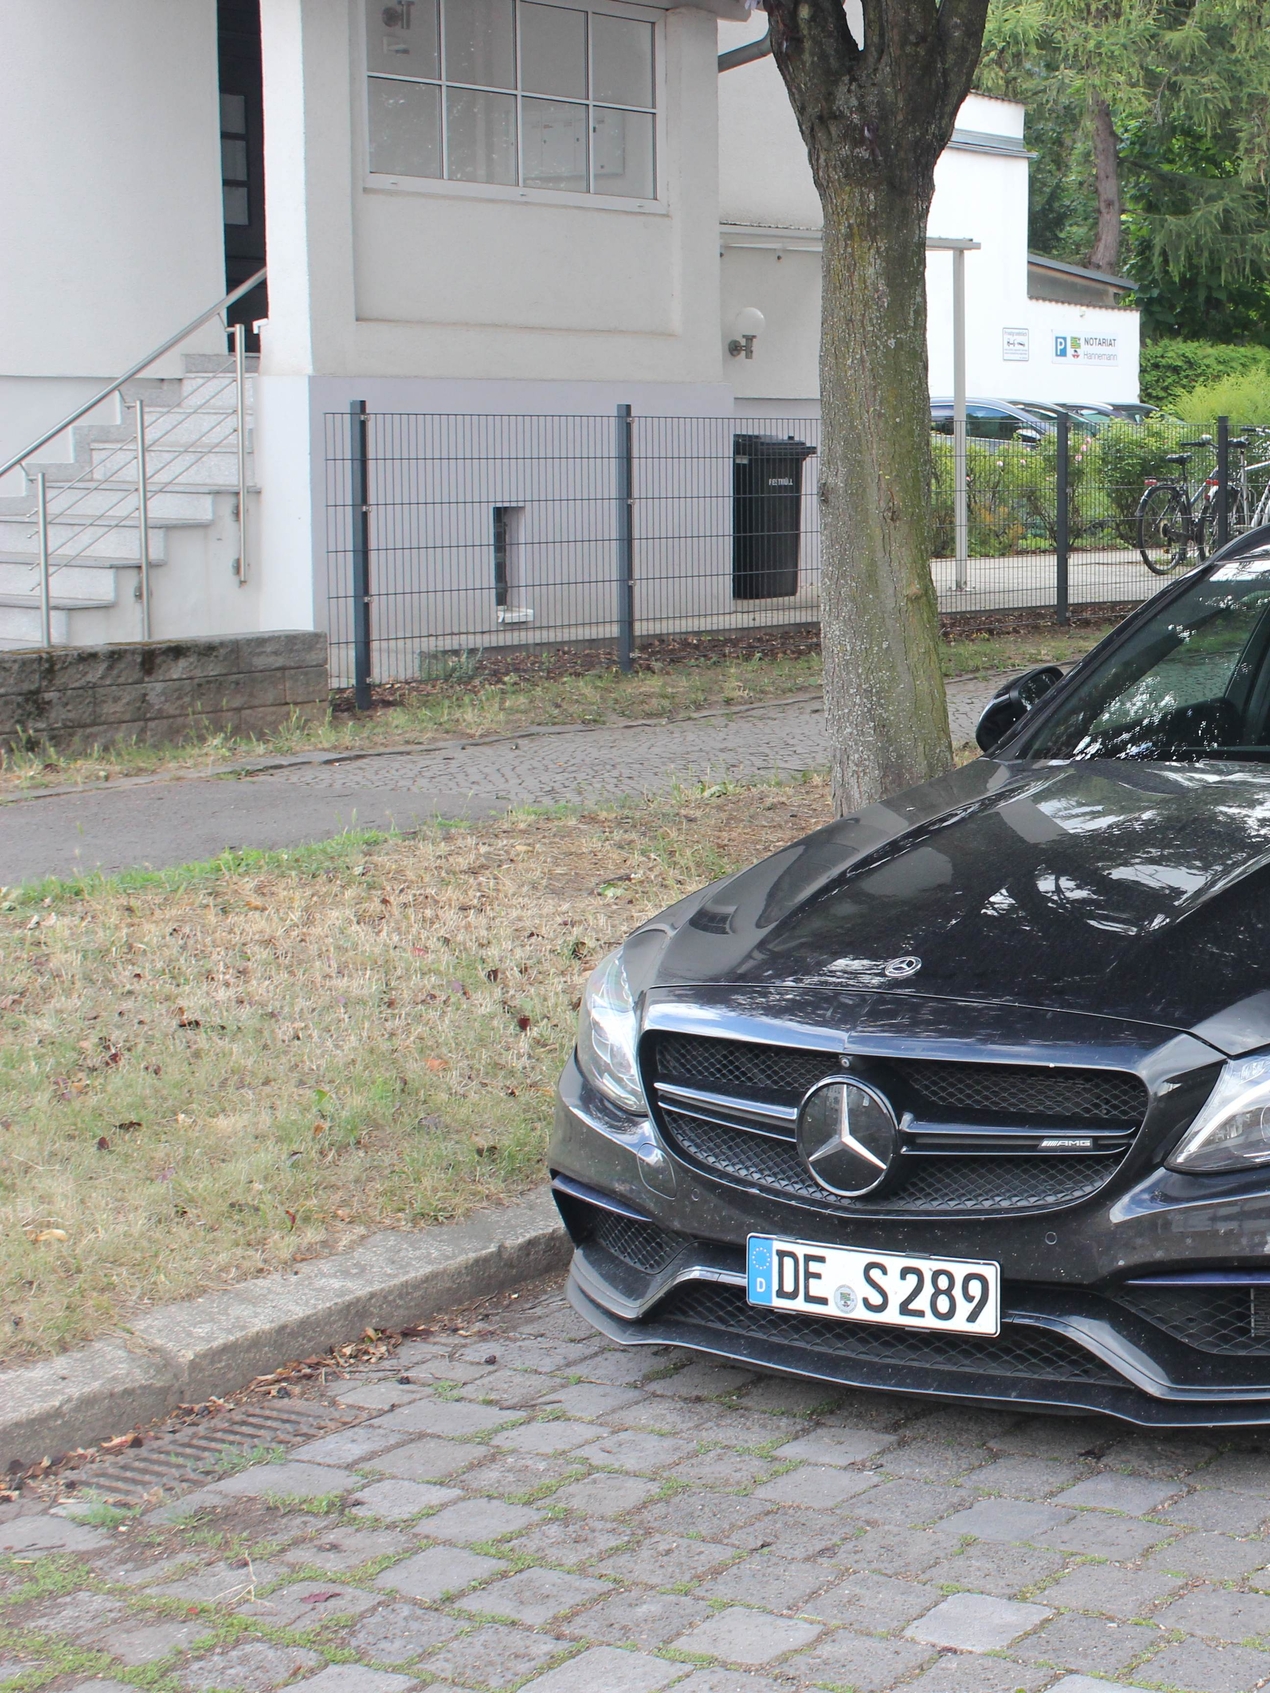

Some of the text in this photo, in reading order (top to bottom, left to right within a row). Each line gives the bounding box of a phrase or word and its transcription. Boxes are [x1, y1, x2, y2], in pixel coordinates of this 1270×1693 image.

[1057, 338, 1066, 356] P
[1084, 337, 1117, 348] NOTARIAT
[1083, 351, 1118, 361] Hannemann
[756, 1278, 766, 1293] D
[775, 1248, 829, 1306] DE
